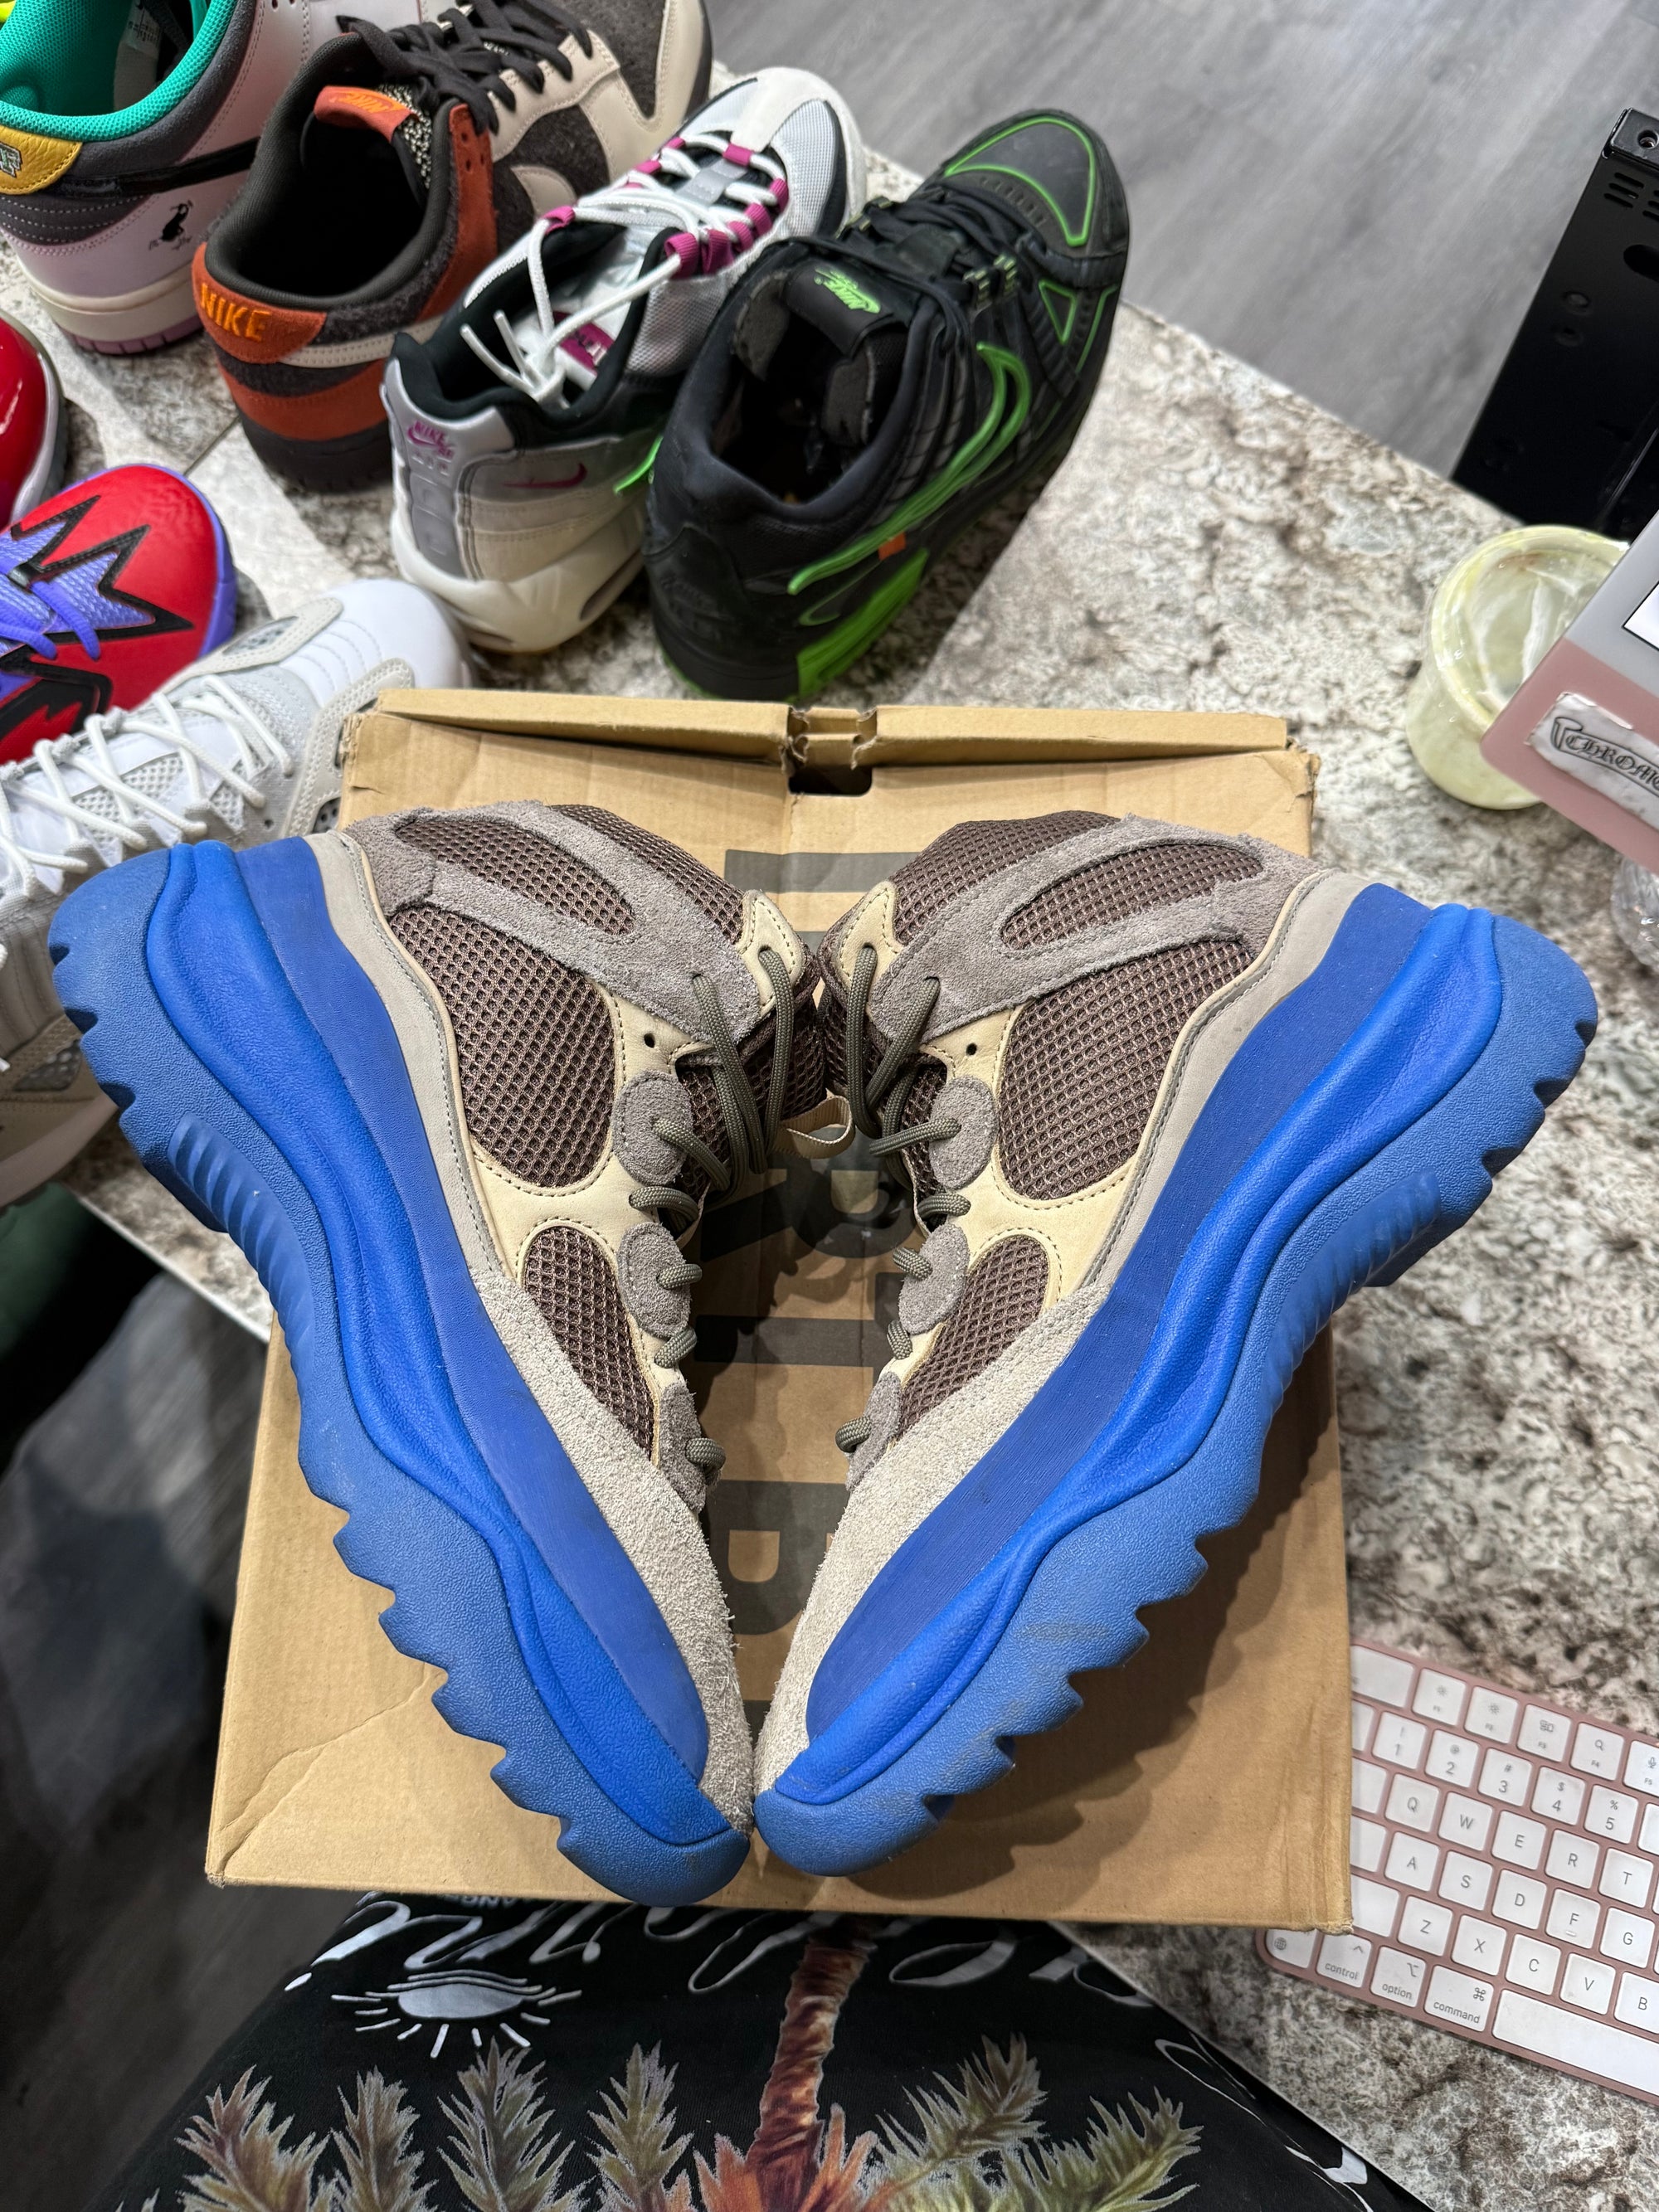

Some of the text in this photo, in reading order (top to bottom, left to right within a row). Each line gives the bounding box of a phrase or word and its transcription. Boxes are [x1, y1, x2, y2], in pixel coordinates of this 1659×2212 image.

[201, 283, 271, 343] NIKE
[1394, 1743, 1401, 1756] 1
[1445, 1761, 1455, 1775] 2
[1591, 1759, 1600, 1768] F4
[1498, 1780, 1508, 1793] 3
[1644, 1777, 1652, 1786] F5
[1407, 1796, 1418, 1812] Q
[1552, 1800, 1561, 1812] 4
[1609, 1799, 1618, 1811] %
[1459, 1814, 1474, 1830] W
[1605, 1816, 1615, 1830] 5
[1514, 1834, 1525, 1848] E
[1407, 1856, 1417, 1870] A
[1568, 1853, 1579, 1867] R
[1460, 1874, 1472, 1889] S
[1623, 1871, 1632, 1885] T
[1514, 1893, 1525, 1907] D
[1569, 1913, 1579, 1925] F
[1419, 1919, 1432, 1934] Z
[1473, 1937, 1486, 1954] X
[1623, 1932, 1633, 1946] G
[1325, 1962, 1359, 1981] control
[1528, 1958, 1540, 1972] C
[1584, 1976, 1594, 1991] V
[1381, 1982, 1413, 2001] option
[1637, 1996, 1649, 2010] B
[1433, 2001, 1481, 2024] command
